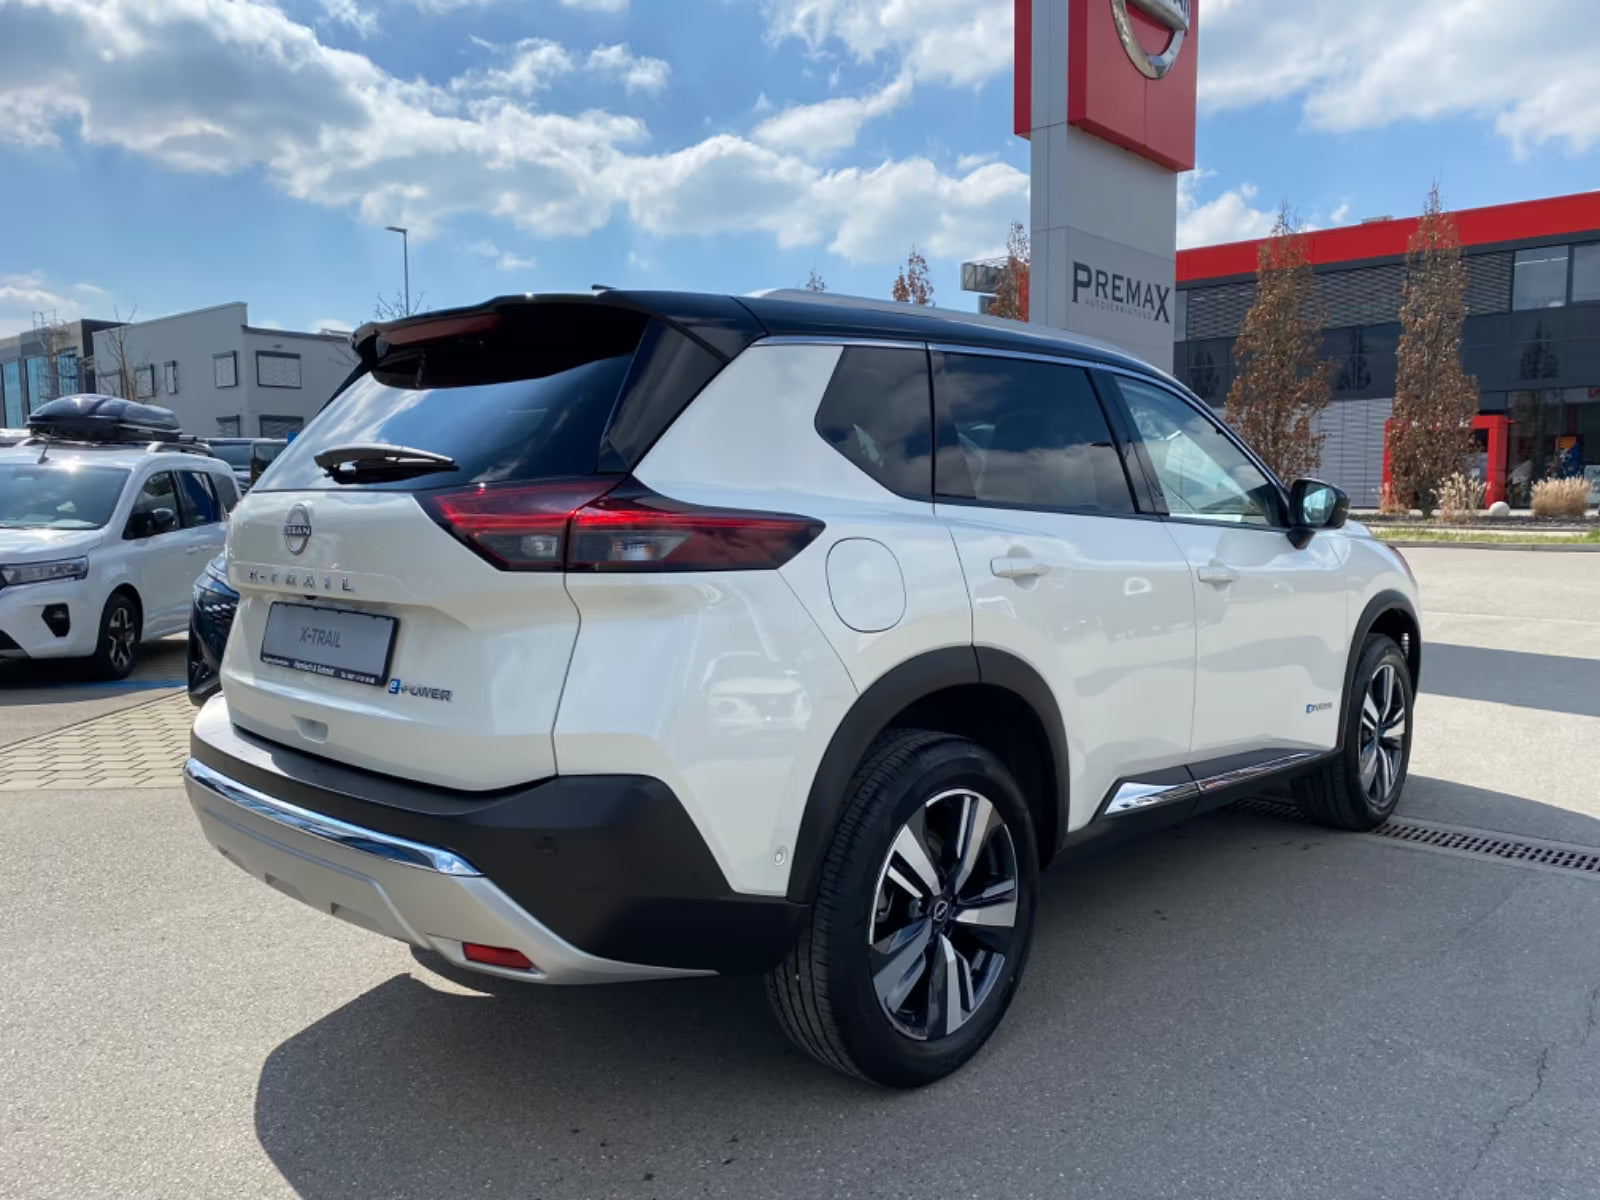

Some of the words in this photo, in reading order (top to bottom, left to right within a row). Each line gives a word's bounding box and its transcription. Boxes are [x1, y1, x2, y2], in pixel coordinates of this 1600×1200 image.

[1072, 261, 1170, 323] PREMAX
[283, 526, 311, 536] SSAN
[248, 568, 355, 593] X-TRAIL
[299, 626, 341, 649] X-TRAIL
